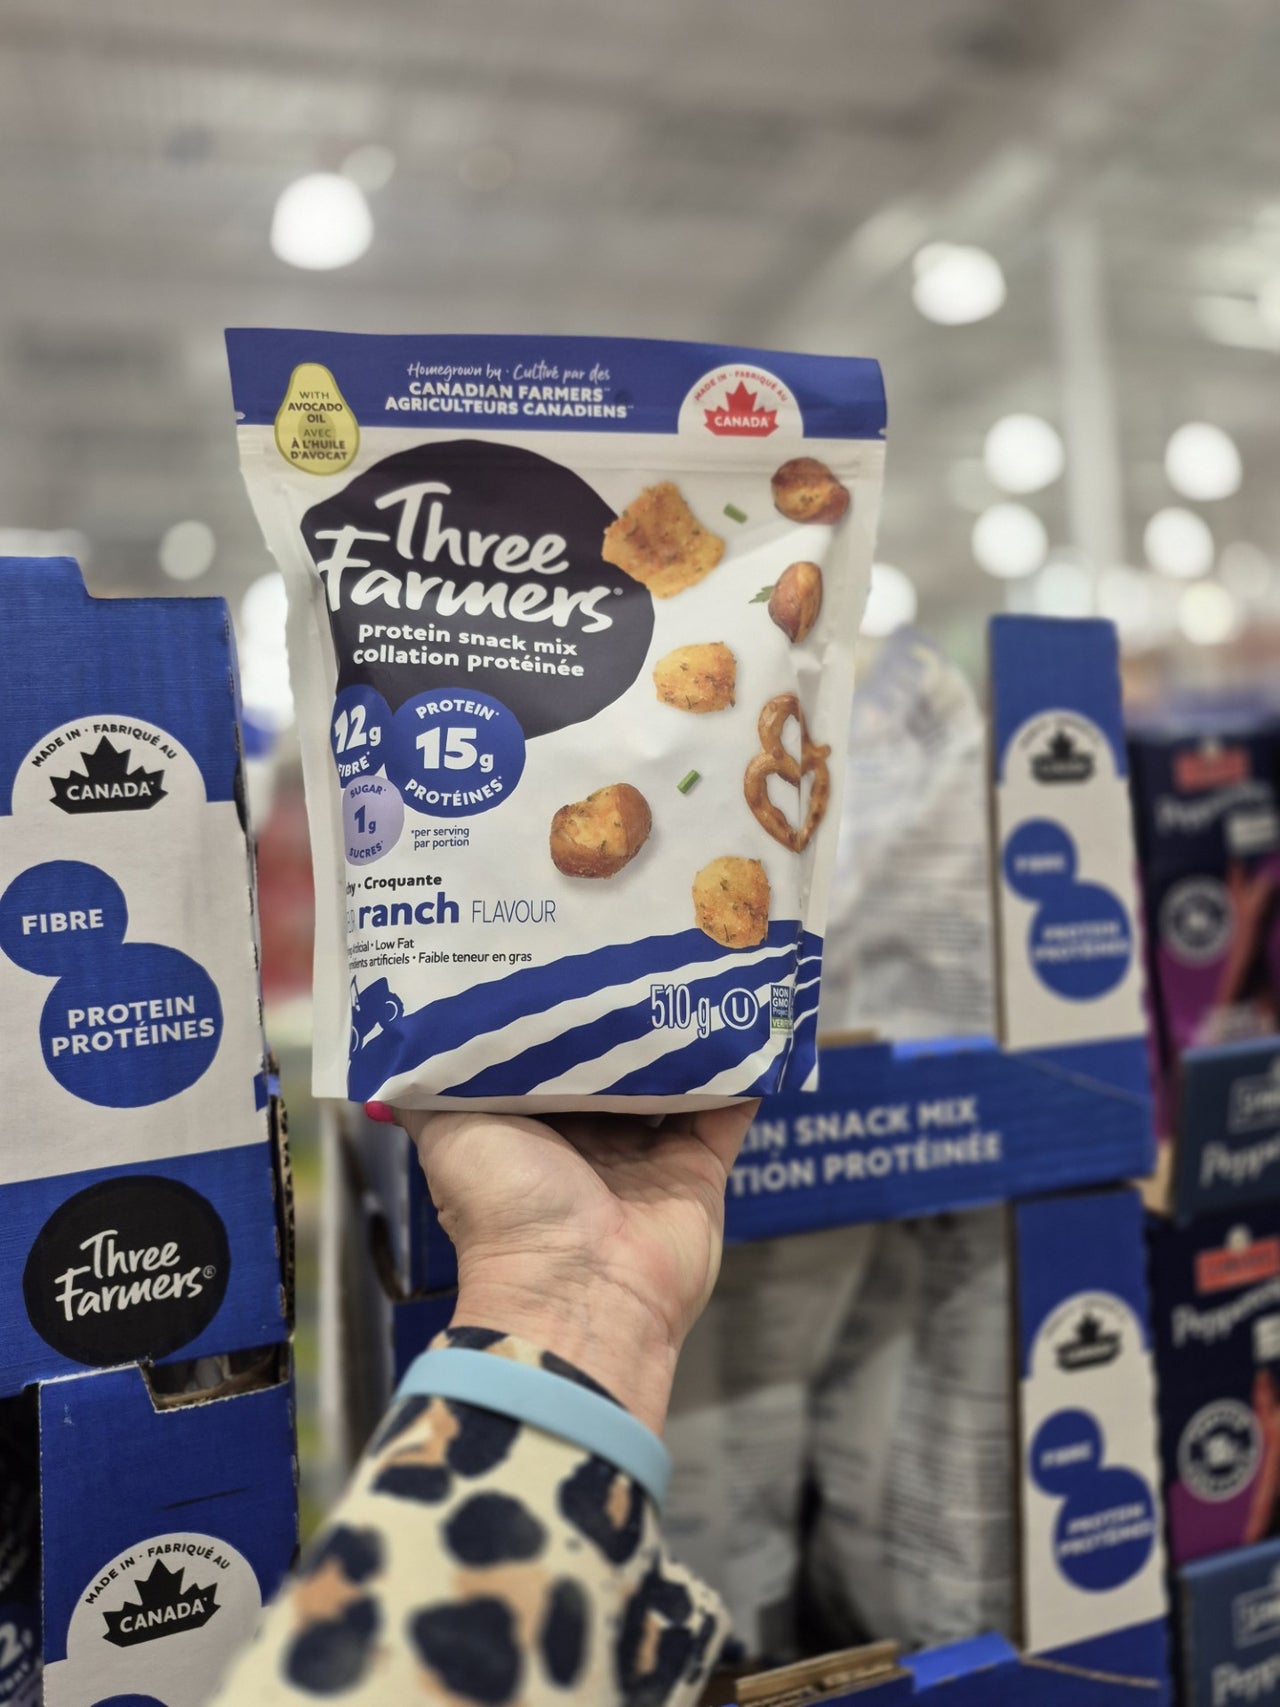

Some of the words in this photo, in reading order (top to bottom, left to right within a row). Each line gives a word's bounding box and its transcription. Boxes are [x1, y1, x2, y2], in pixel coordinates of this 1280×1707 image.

[406, 362, 482, 381] Homegrown
[486, 363, 502, 381] by
[513, 362, 560, 381] Cultivé
[563, 371, 586, 384] par
[589, 363, 611, 382] des
[299, 391, 330, 400] WITH
[408, 382, 513, 399] CANADIAN
[518, 384, 604, 402] FARMERS
[693, 378, 717, 402] MADE
[717, 373, 728, 382] IN
[734, 370, 778, 390] FABRIQUÉ
[776, 390, 788, 402] AU
[288, 402, 343, 412] AVOCADO
[385, 397, 519, 415] AGRICULTEURS
[523, 402, 628, 418] CANADIENS
[307, 413, 326, 424] OIL
[714, 416, 769, 428] CANADA
[291, 437, 300, 449] À
[302, 439, 346, 450] L'HUILE
[303, 428, 332, 438] AVEC
[290, 450, 348, 461] D'AVOCAT
[375, 481, 569, 574] Three
[315, 525, 613, 633] Farmers
[358, 623, 451, 644] protein
[458, 631, 528, 651] snack
[533, 639, 578, 656] mix
[353, 645, 460, 667] collation
[467, 653, 585, 677] protéinée
[31, 736, 65, 768] MADE
[66, 728, 81, 741] IN
[93, 724, 161, 746] FABRIQUÉ
[159, 743, 178, 760] AU
[66, 781, 153, 800] CANADA
[433, 825, 470, 838] serving
[413, 839, 430, 851] par
[432, 836, 470, 850] portion
[363, 875, 442, 892] Croquante
[22, 908, 104, 935] FIBRE
[358, 891, 460, 930] ranch
[471, 899, 556, 924] FLAVOUR
[375, 940, 395, 951] Low
[397, 938, 415, 949] Fat
[369, 953, 410, 968] artificiels
[418, 951, 450, 964] Faible
[452, 952, 490, 963] teneur
[492, 953, 507, 963] en
[508, 952, 532, 965] gras
[67, 995, 196, 1030] PROTEIN
[650, 984, 691, 1030] 510
[697, 997, 711, 1039] g
[52, 1017, 215, 1057] PROTÉINES
[795, 1105, 910, 1146] SNACK
[917, 1095, 978, 1130] MIX
[79, 1229, 180, 1280] Three
[85, 1568, 118, 1605] MADE
[120, 1556, 136, 1571] IN
[147, 1542, 215, 1560] FABRIQUÉ
[212, 1555, 231, 1570] AU
[119, 1598, 206, 1633] CANADA
